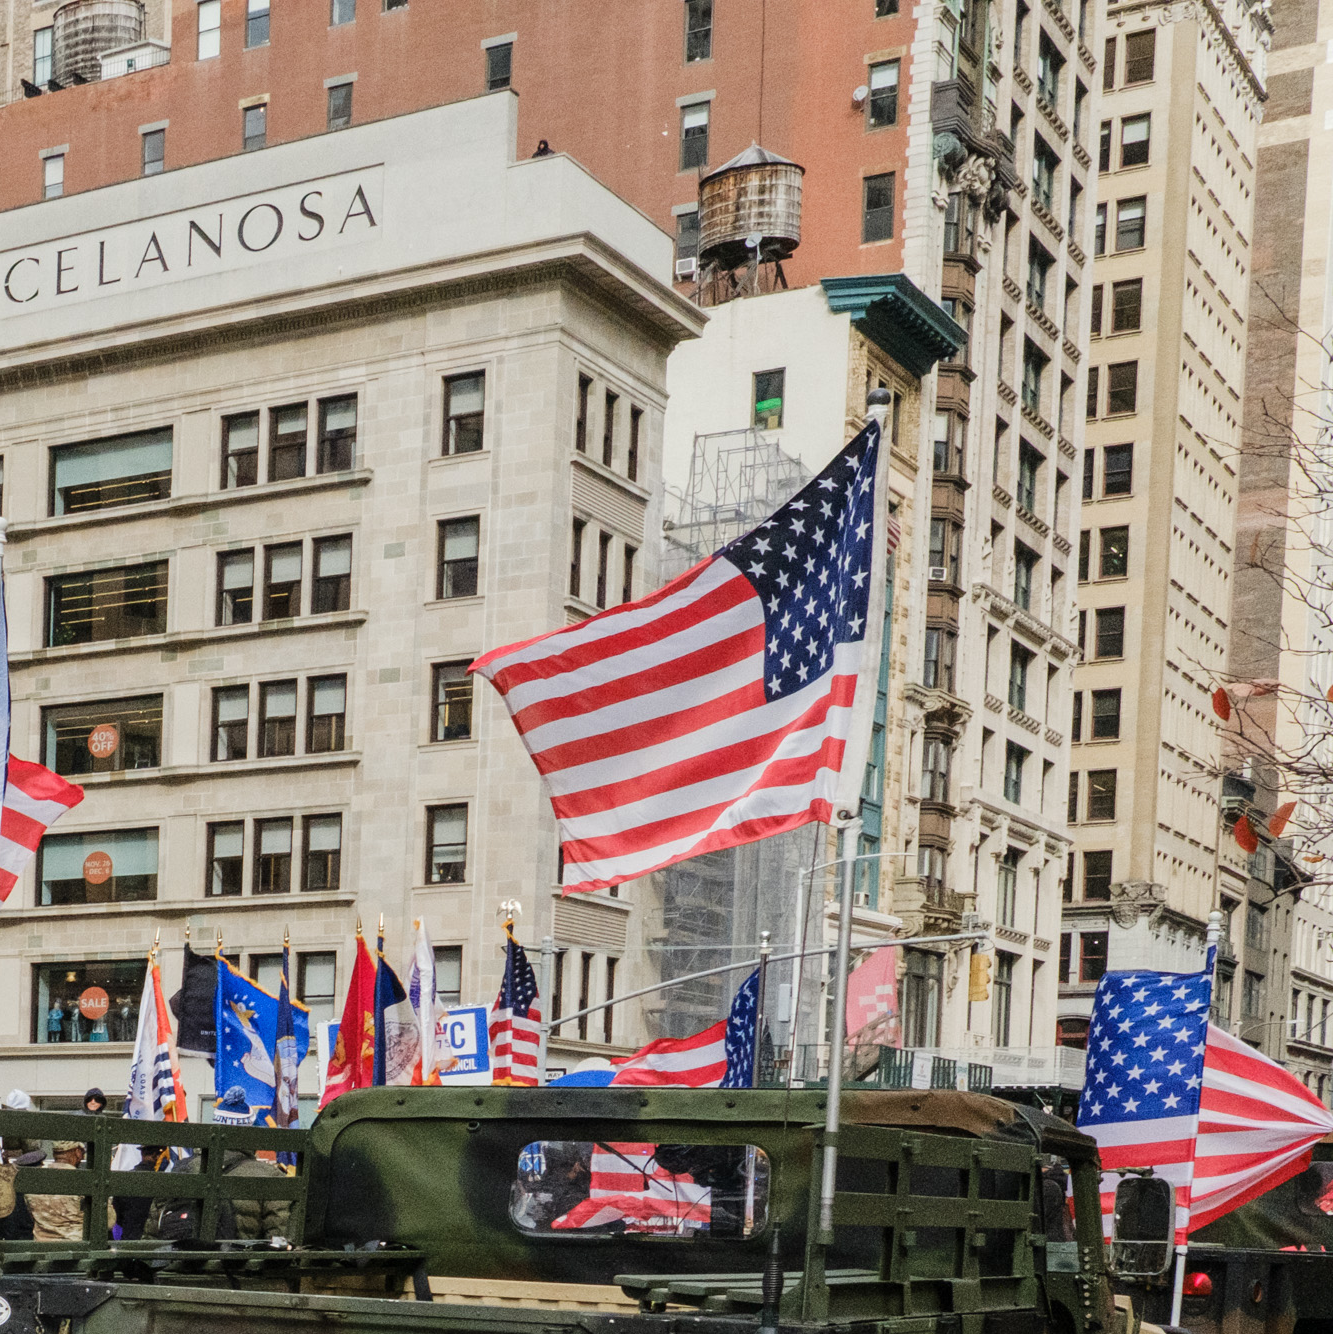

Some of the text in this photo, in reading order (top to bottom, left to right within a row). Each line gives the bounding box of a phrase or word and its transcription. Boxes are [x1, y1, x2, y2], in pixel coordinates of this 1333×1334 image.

[91, 731, 115, 742] 40%
[91, 740, 114, 752] OFF
[80, 998, 107, 1008] SALE
[440, 1058, 477, 1073] UNCIL
[139, 1073, 147, 1101] COAST
